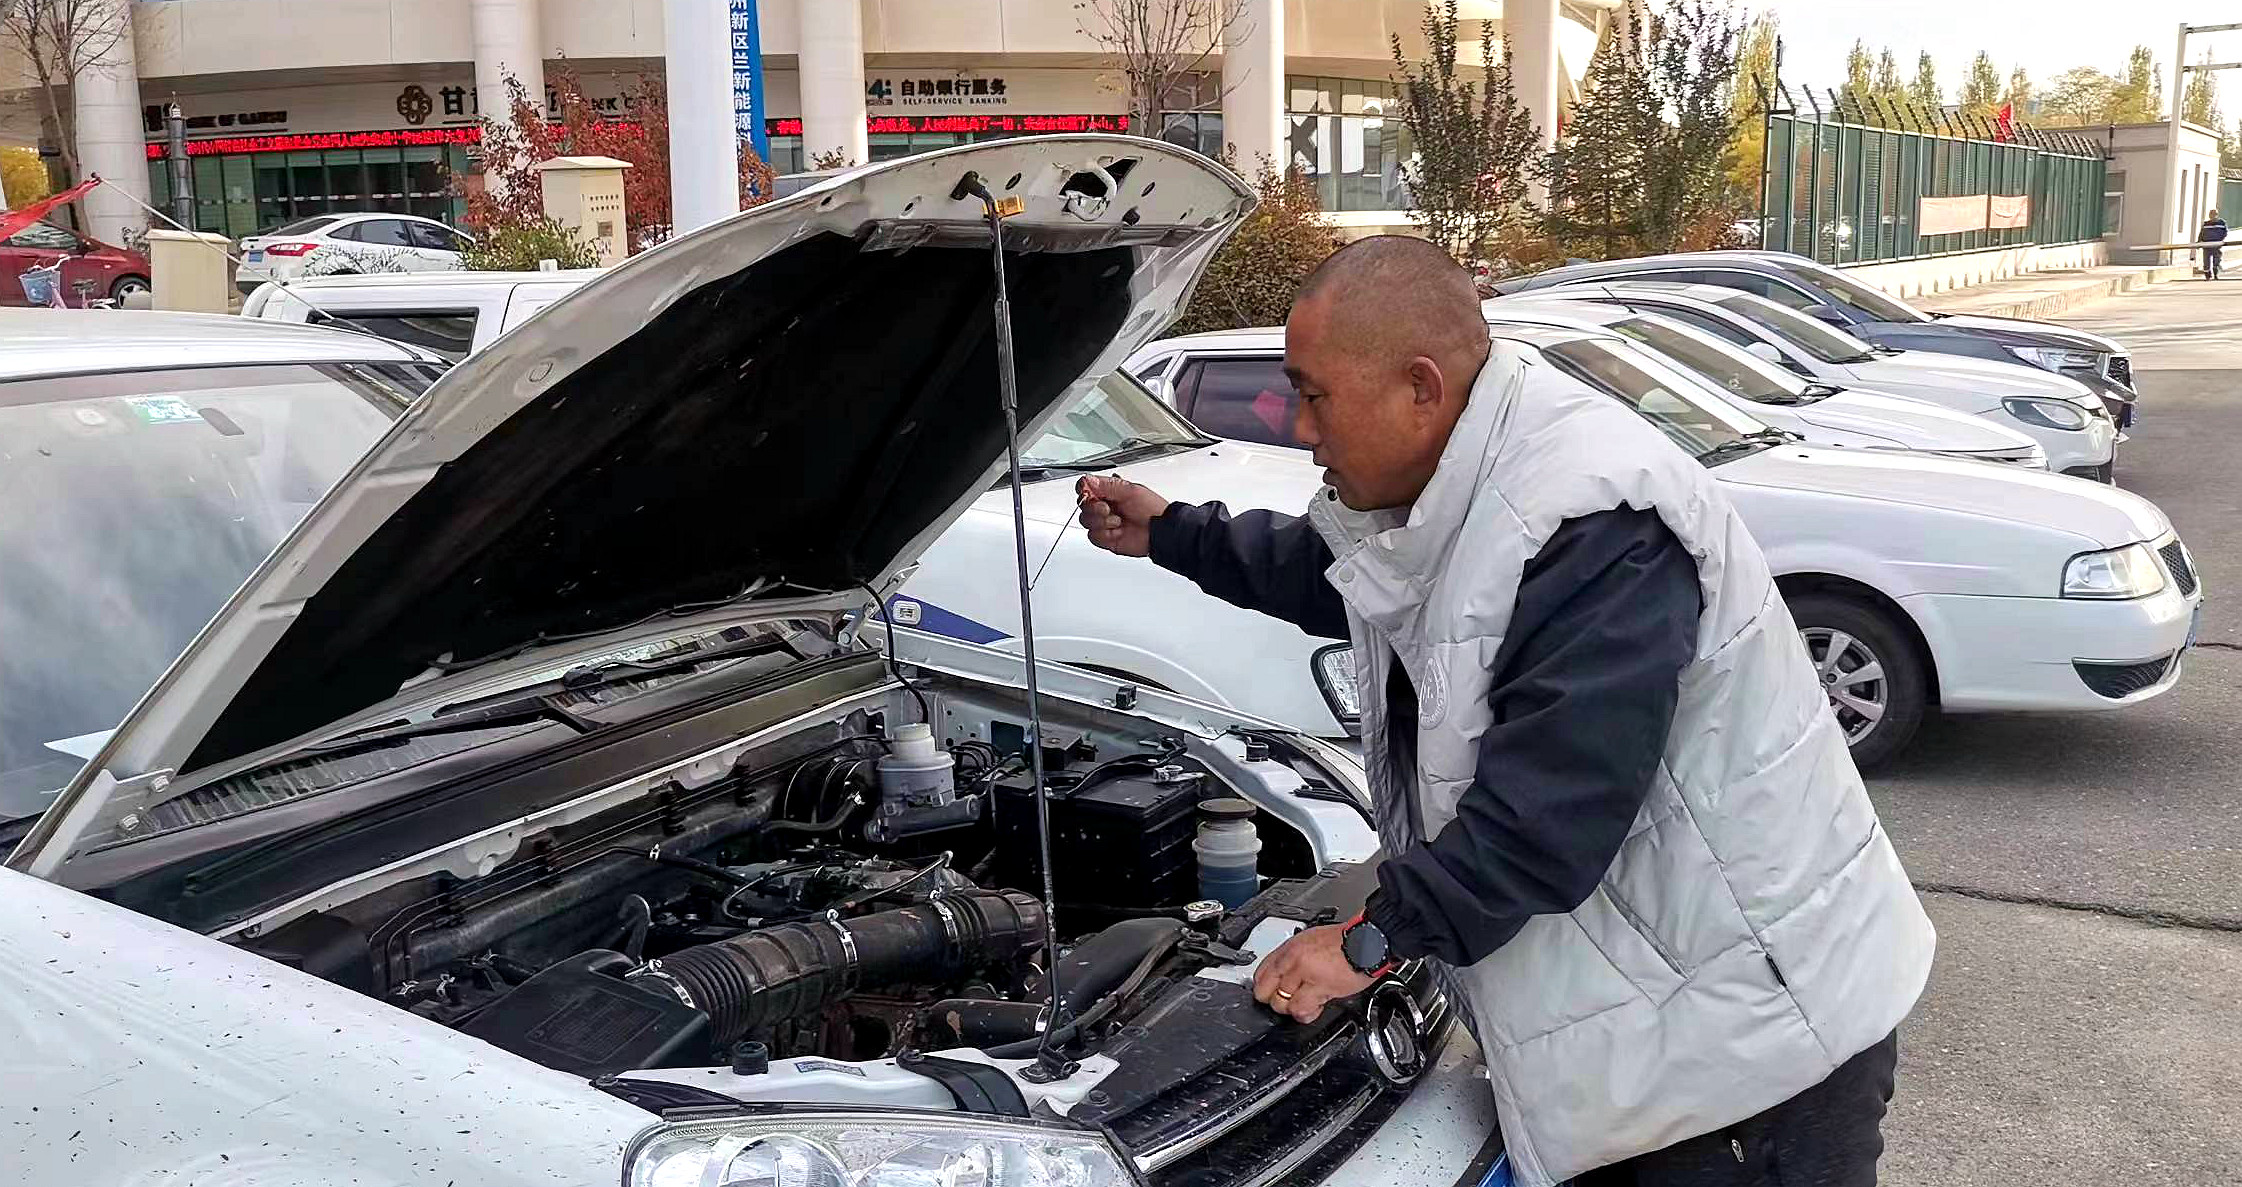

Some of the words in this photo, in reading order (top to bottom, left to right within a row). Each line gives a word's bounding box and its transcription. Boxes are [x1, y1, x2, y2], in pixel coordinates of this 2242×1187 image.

[901, 79, 1007, 96] 自助银行服务
